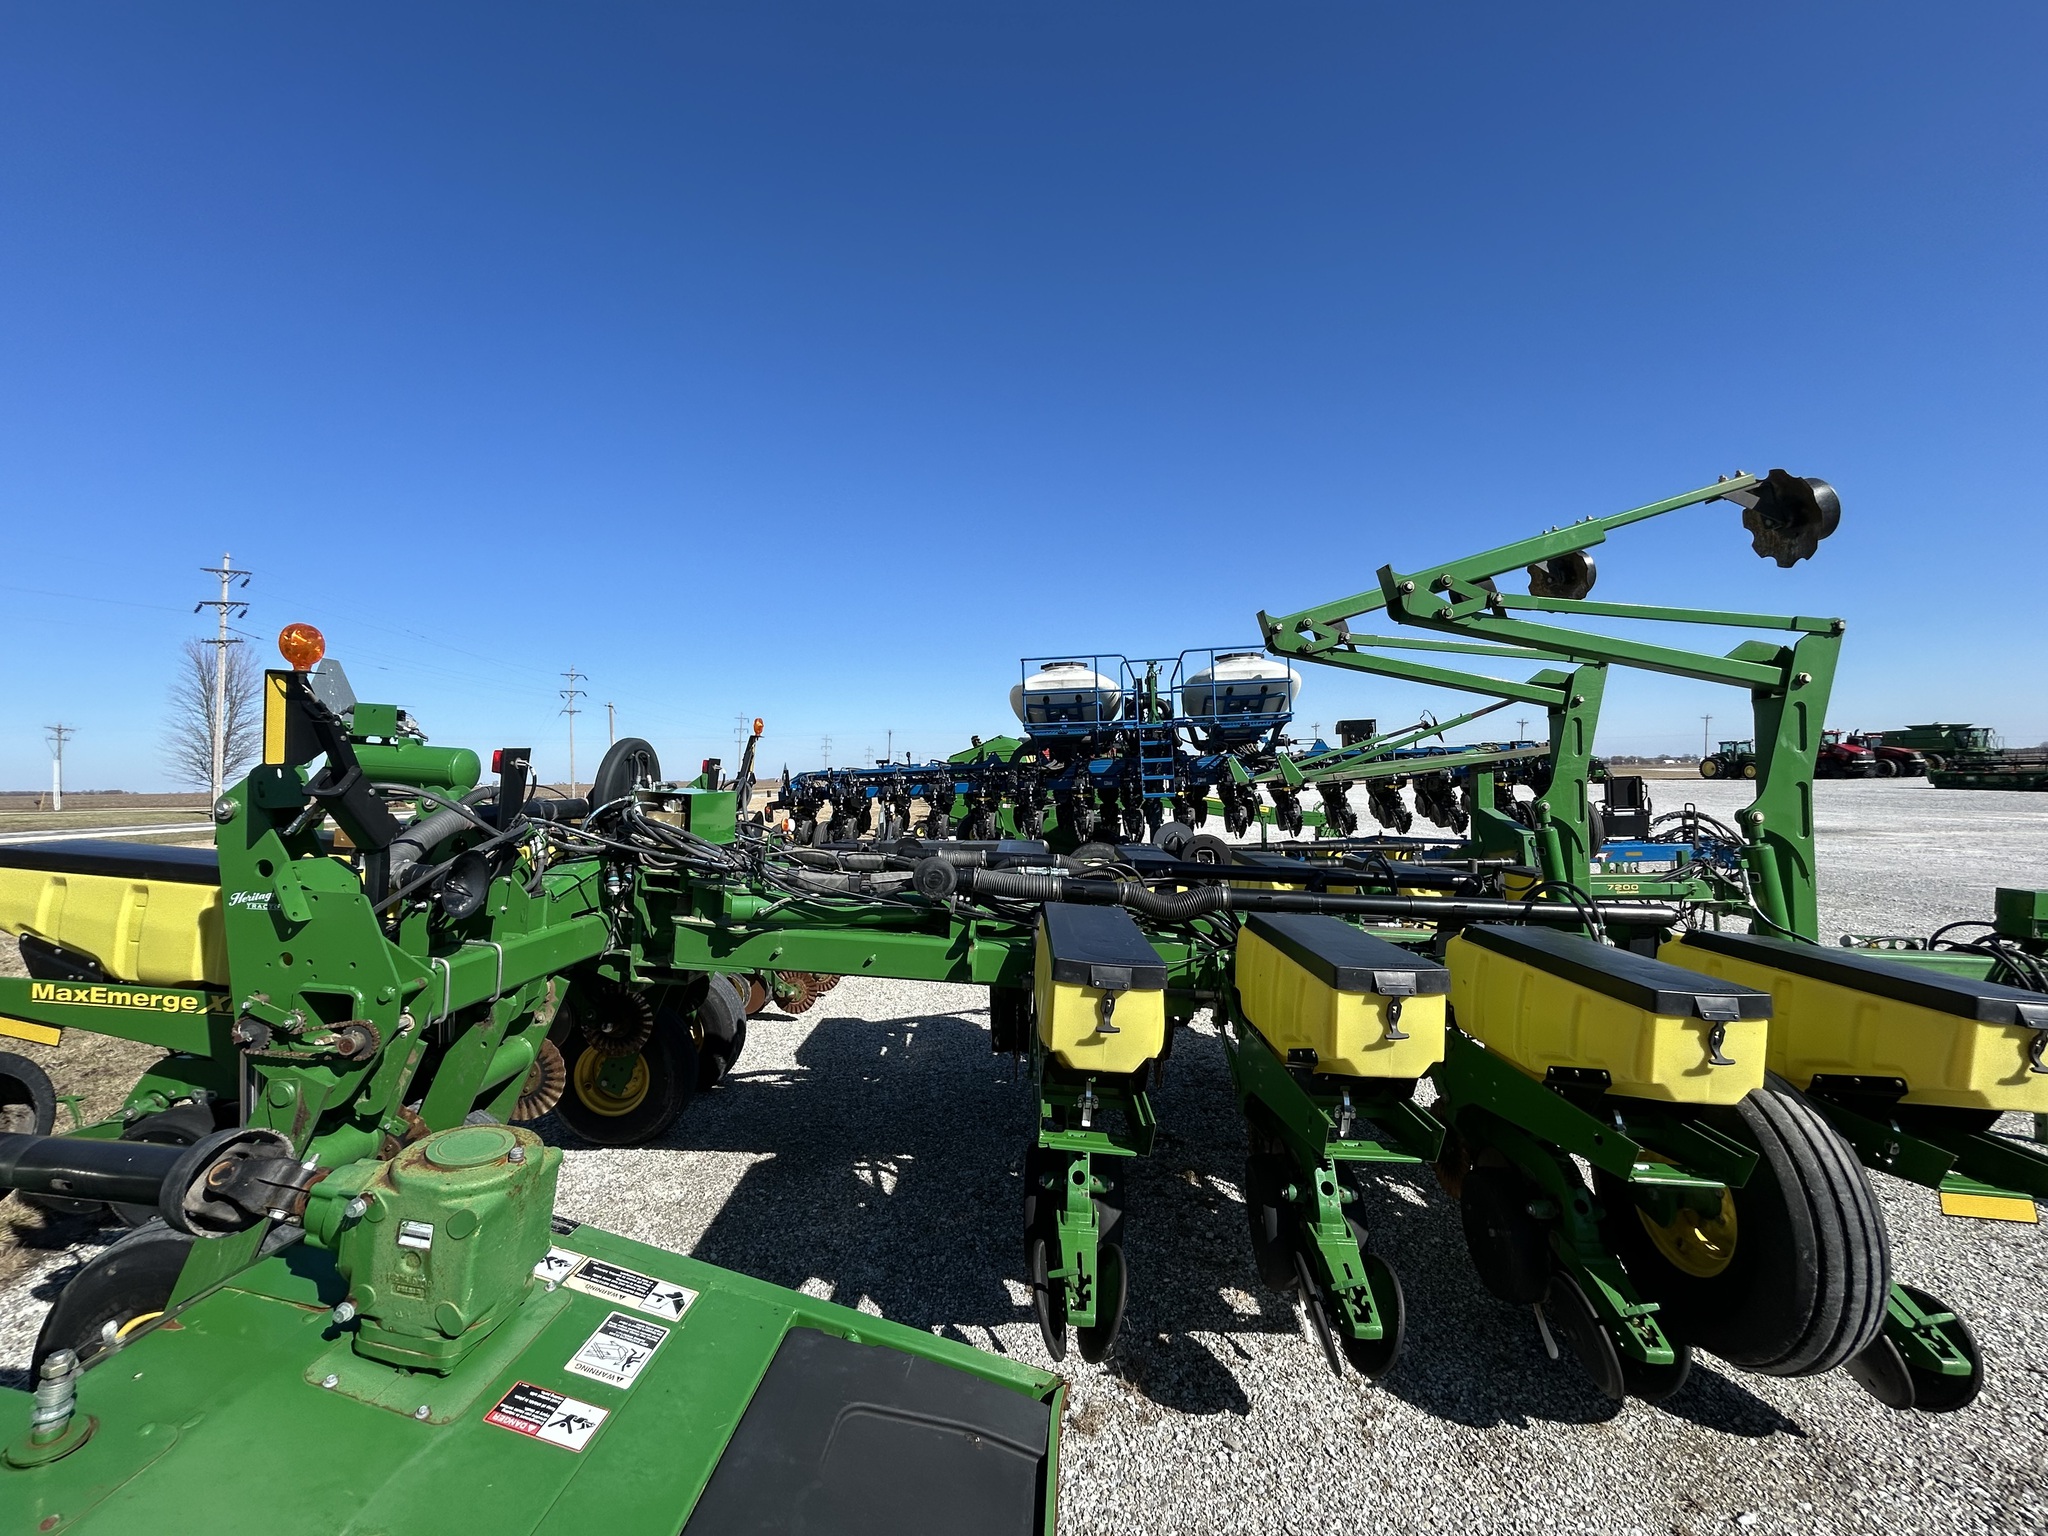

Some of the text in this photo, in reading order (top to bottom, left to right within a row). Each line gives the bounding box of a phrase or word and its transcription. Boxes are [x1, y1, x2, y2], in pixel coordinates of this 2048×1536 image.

[31, 982, 234, 1014] MaxEmerge X
[585, 1283, 618, 1298] WARNING
[574, 1363, 616, 1381] WARNING
[492, 1412, 528, 1431] DANGER
